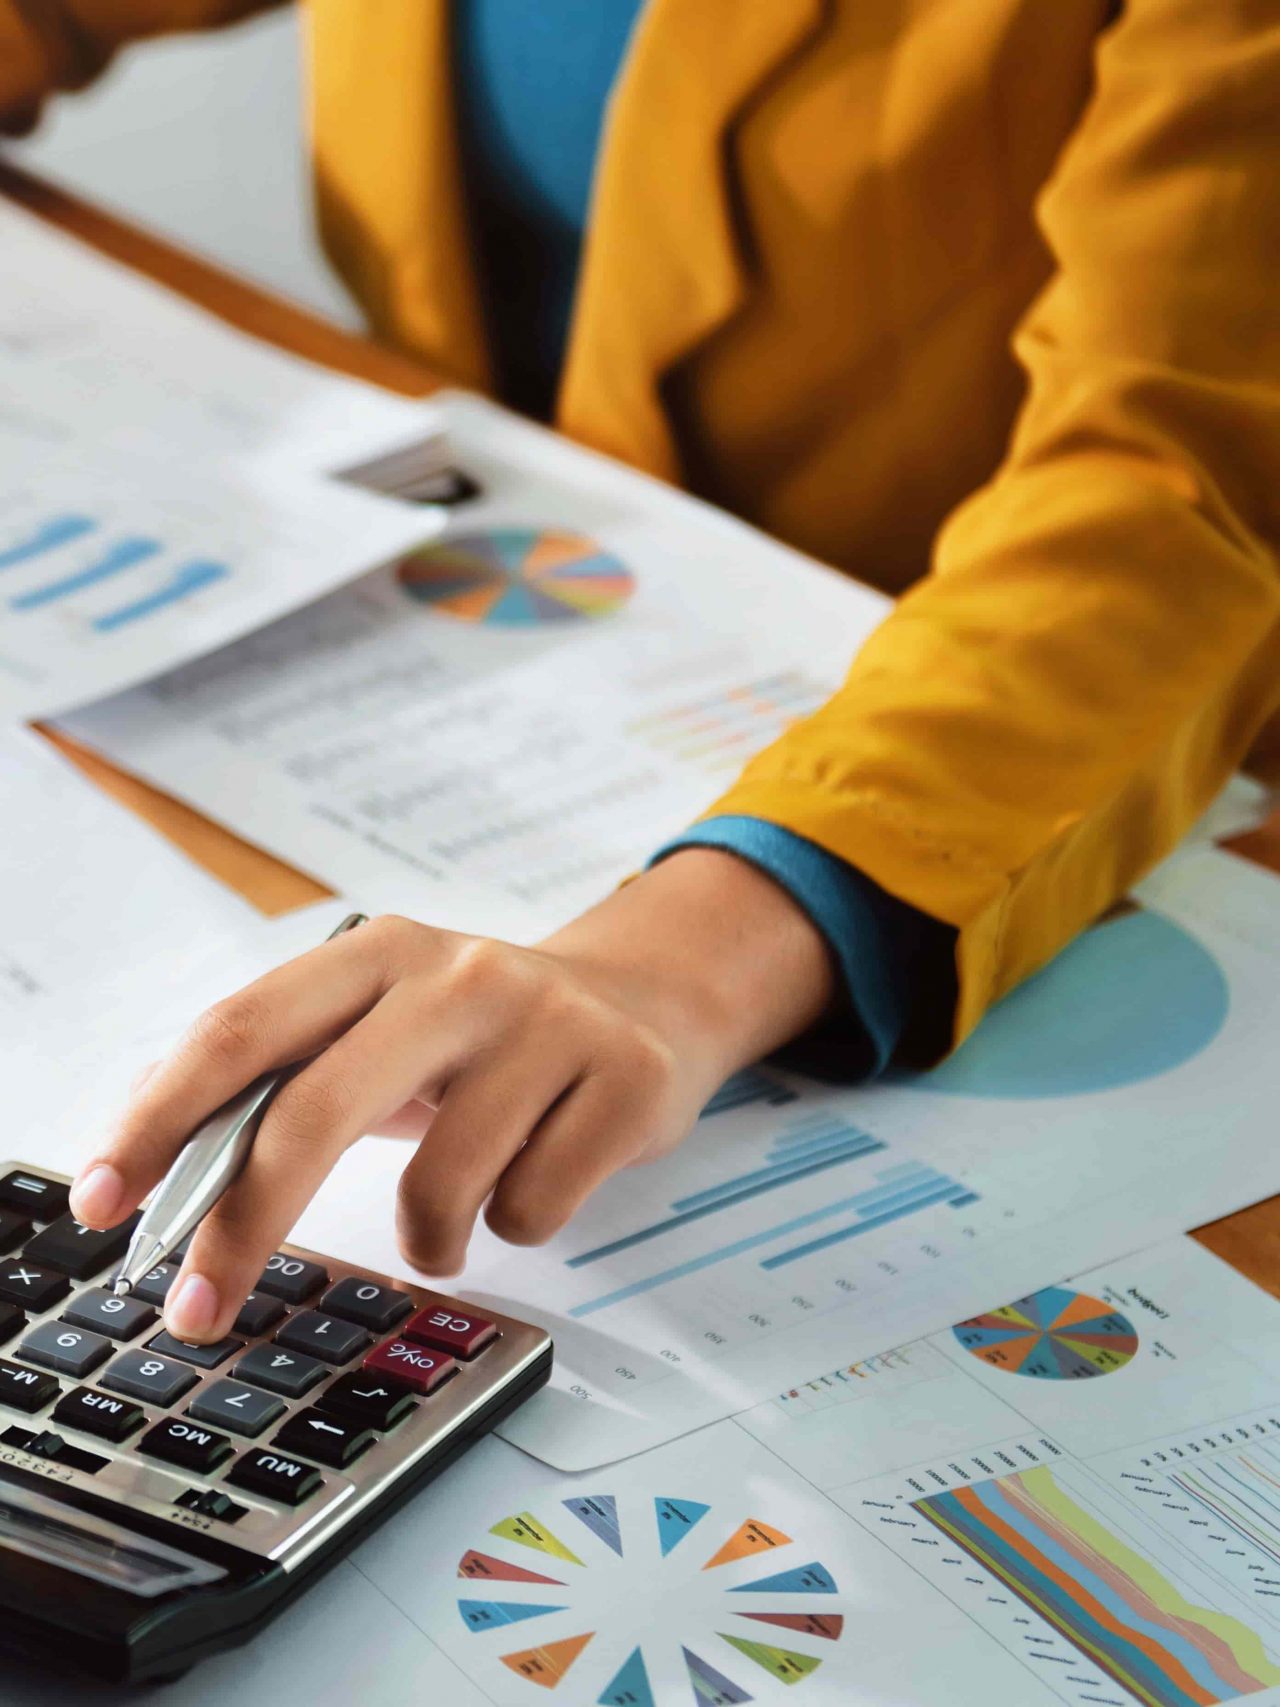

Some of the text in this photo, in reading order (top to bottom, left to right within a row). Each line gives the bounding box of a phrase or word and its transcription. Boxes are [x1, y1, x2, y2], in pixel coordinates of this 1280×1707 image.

[100, 1299, 126, 1313] 6
[314, 1321, 332, 1334] 1
[429, 1312, 471, 1333] CE
[56, 1333, 82, 1347] 9
[270, 1354, 296, 1367] 4
[389, 1343, 435, 1369] ON/C
[139, 1361, 165, 1376] 8
[615, 1367, 637, 1380] 450
[570, 1385, 593, 1400] 500
[81, 1391, 124, 1414] MR
[224, 1392, 252, 1408] 7
[168, 1424, 211, 1446] MC
[256, 1457, 302, 1478] MU
[1120, 1472, 1154, 1483] january
[1134, 1485, 1172, 1498] february
[862, 1499, 896, 1510] january
[1161, 1502, 1190, 1512] march
[879, 1516, 917, 1528] february
[1188, 1519, 1209, 1527] april
[912, 1537, 939, 1546] march
